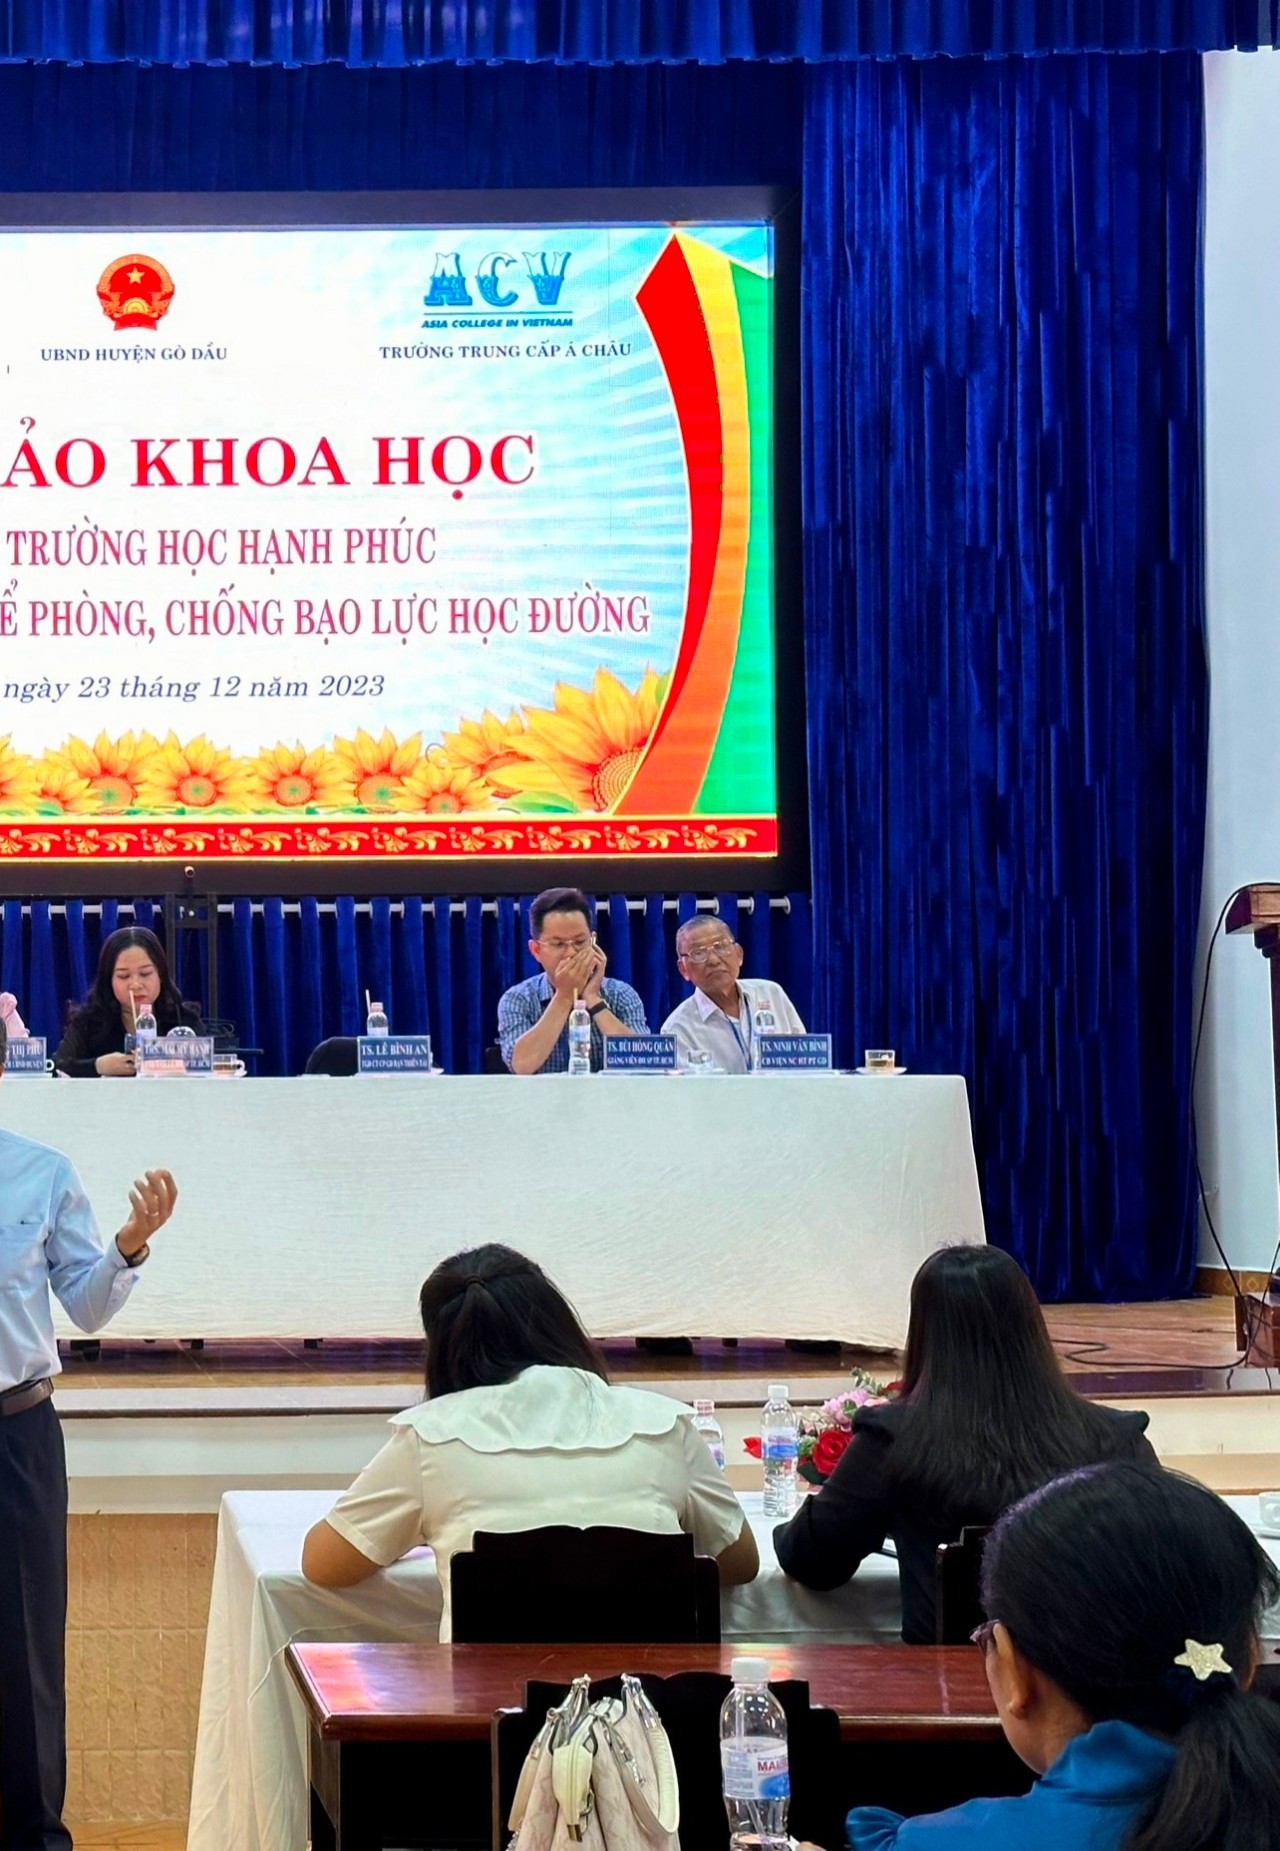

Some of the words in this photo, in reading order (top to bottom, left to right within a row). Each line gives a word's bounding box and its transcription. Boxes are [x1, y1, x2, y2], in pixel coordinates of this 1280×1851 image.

[423, 251, 573, 308] ACV
[421, 319, 448, 329] ASIA
[452, 318, 504, 329] COLLEGE
[506, 318, 519, 328] IN
[522, 318, 574, 328] VIETNAM
[41, 348, 91, 361] UBND
[95, 344, 156, 363] HUYỆN
[161, 344, 186, 361] GÒ
[379, 342, 453, 359] TRƯỜNG
[458, 345, 521, 358] TRUNG
[526, 339, 562, 358] CẤP
[565, 342, 577, 357] Á
[582, 340, 632, 357] CHÂU
[130, 435, 352, 488] KHOA
[372, 434, 535, 502] HỌC
[6, 515, 147, 566] TRƯỜNG
[158, 528, 228, 576] HỌC
[238, 527, 333, 575] HẠNH
[344, 516, 436, 564] PHÚC
[29, 590, 156, 644] PHÒNG,
[165, 583, 284, 637] CHỐNG
[294, 598, 362, 646] BẠO
[371, 592, 438, 646] LỰC
[448, 597, 518, 645] HỌC
[528, 582, 650, 634] ĐƯỜNG
[3, 676, 69, 704] ngày
[77, 676, 112, 698] 23
[120, 675, 200, 702] tháng
[210, 676, 241, 698] 12
[249, 675, 309, 698] năm
[319, 675, 386, 698] 2023
[361, 1044, 374, 1055] TS.
[414, 1044, 428, 1055] AN
